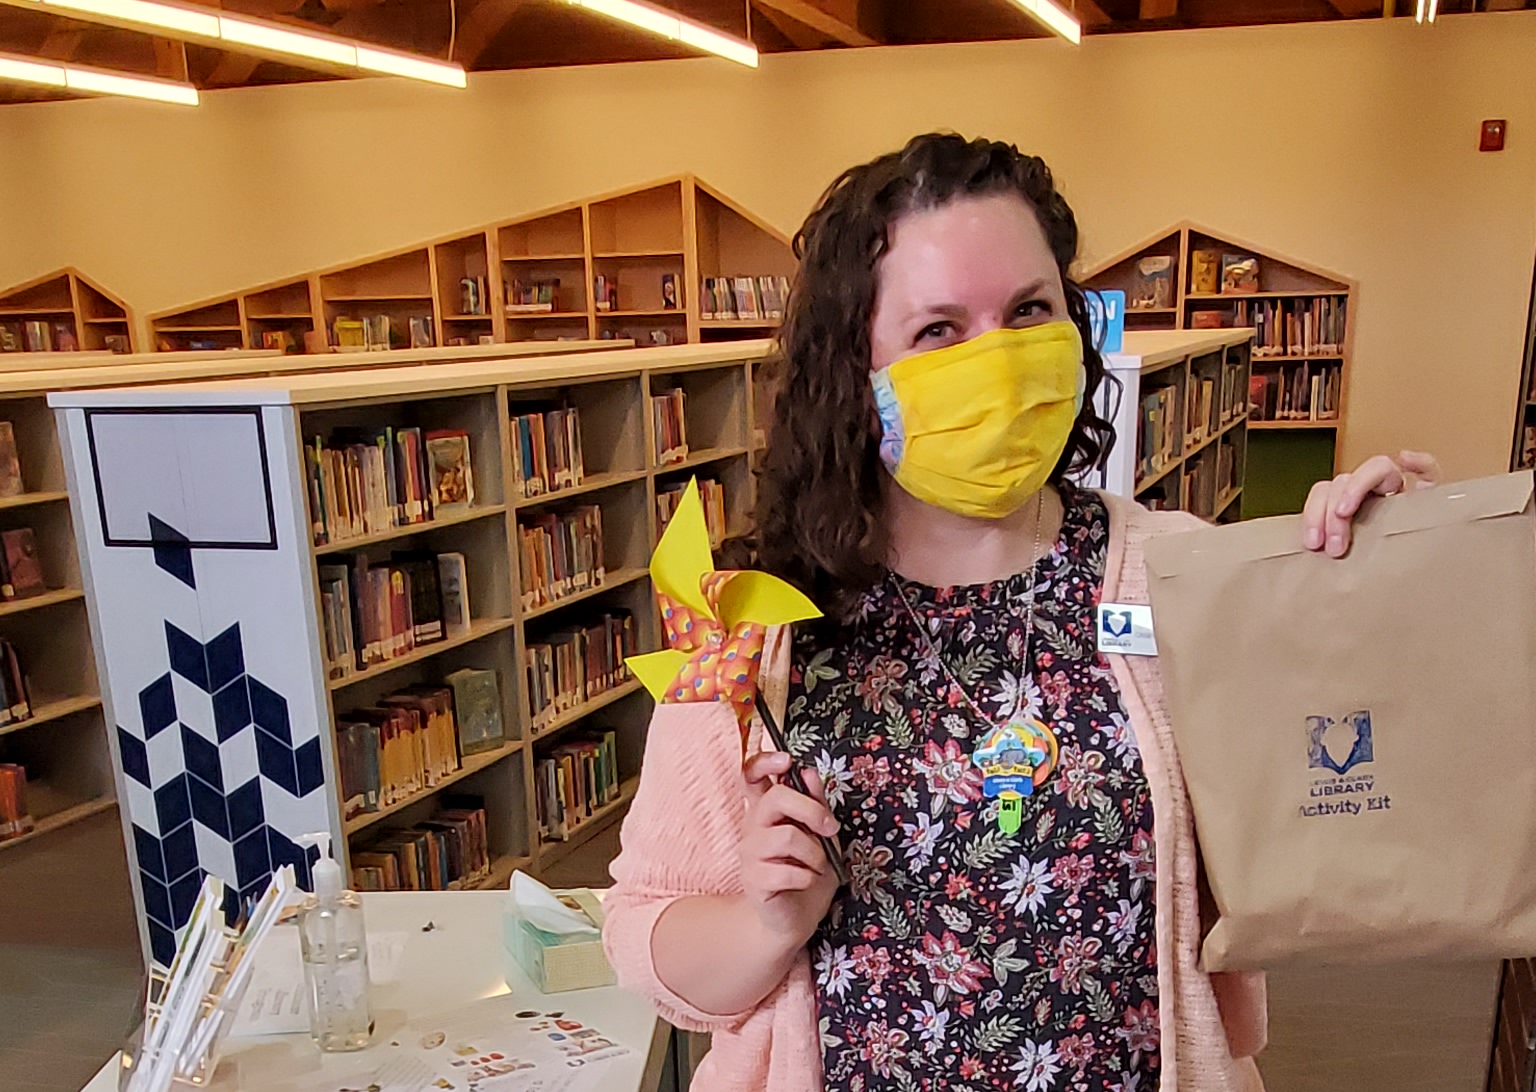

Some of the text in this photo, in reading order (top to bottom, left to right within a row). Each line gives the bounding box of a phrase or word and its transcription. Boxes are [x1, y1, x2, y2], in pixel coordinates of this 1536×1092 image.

[1310, 781, 1374, 797] LIBRARY
[1298, 795, 1391, 817] Activity Kit
